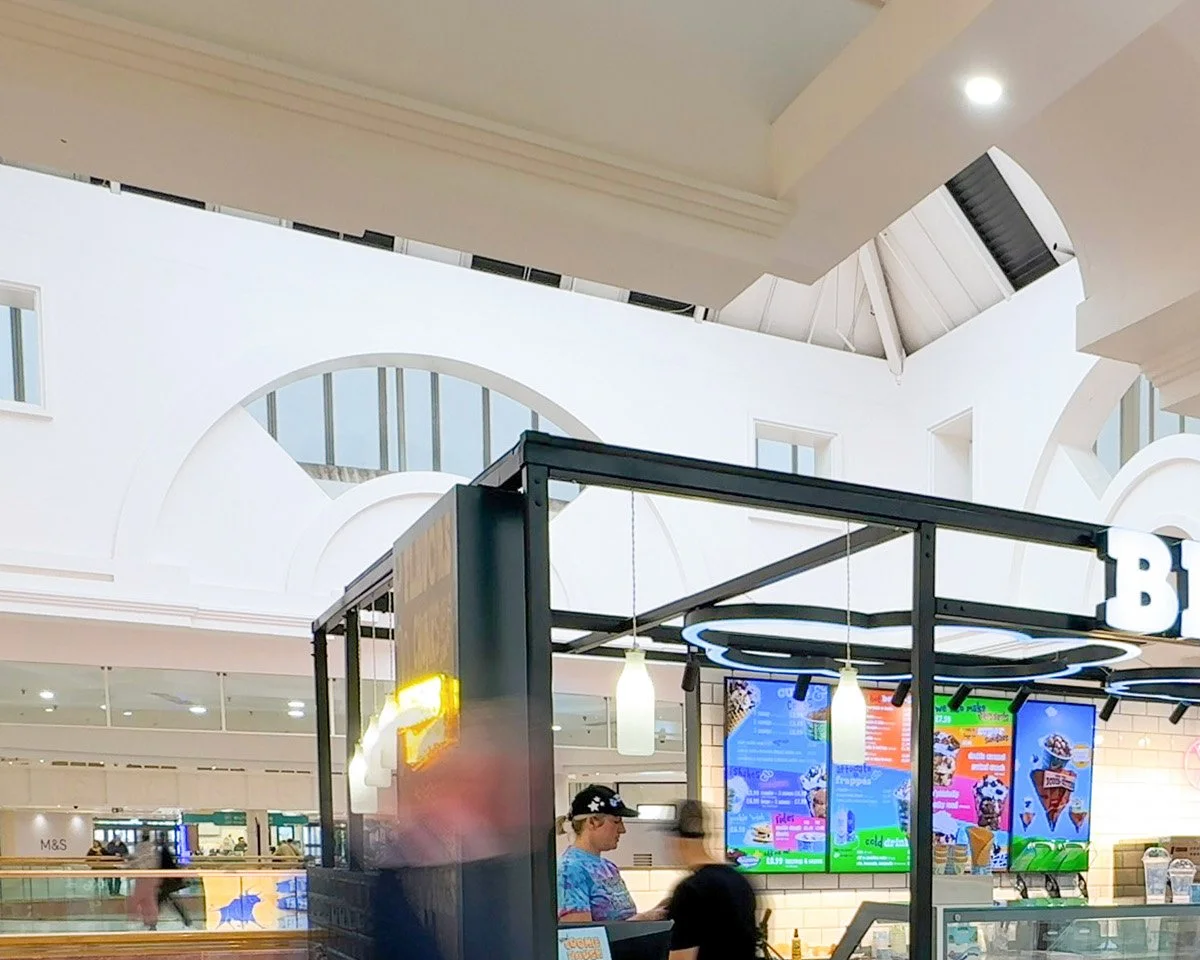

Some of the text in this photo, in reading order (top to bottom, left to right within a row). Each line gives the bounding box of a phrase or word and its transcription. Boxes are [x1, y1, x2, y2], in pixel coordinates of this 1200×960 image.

[40, 838, 67, 851] M&S
[864, 835, 909, 849] cold drin
